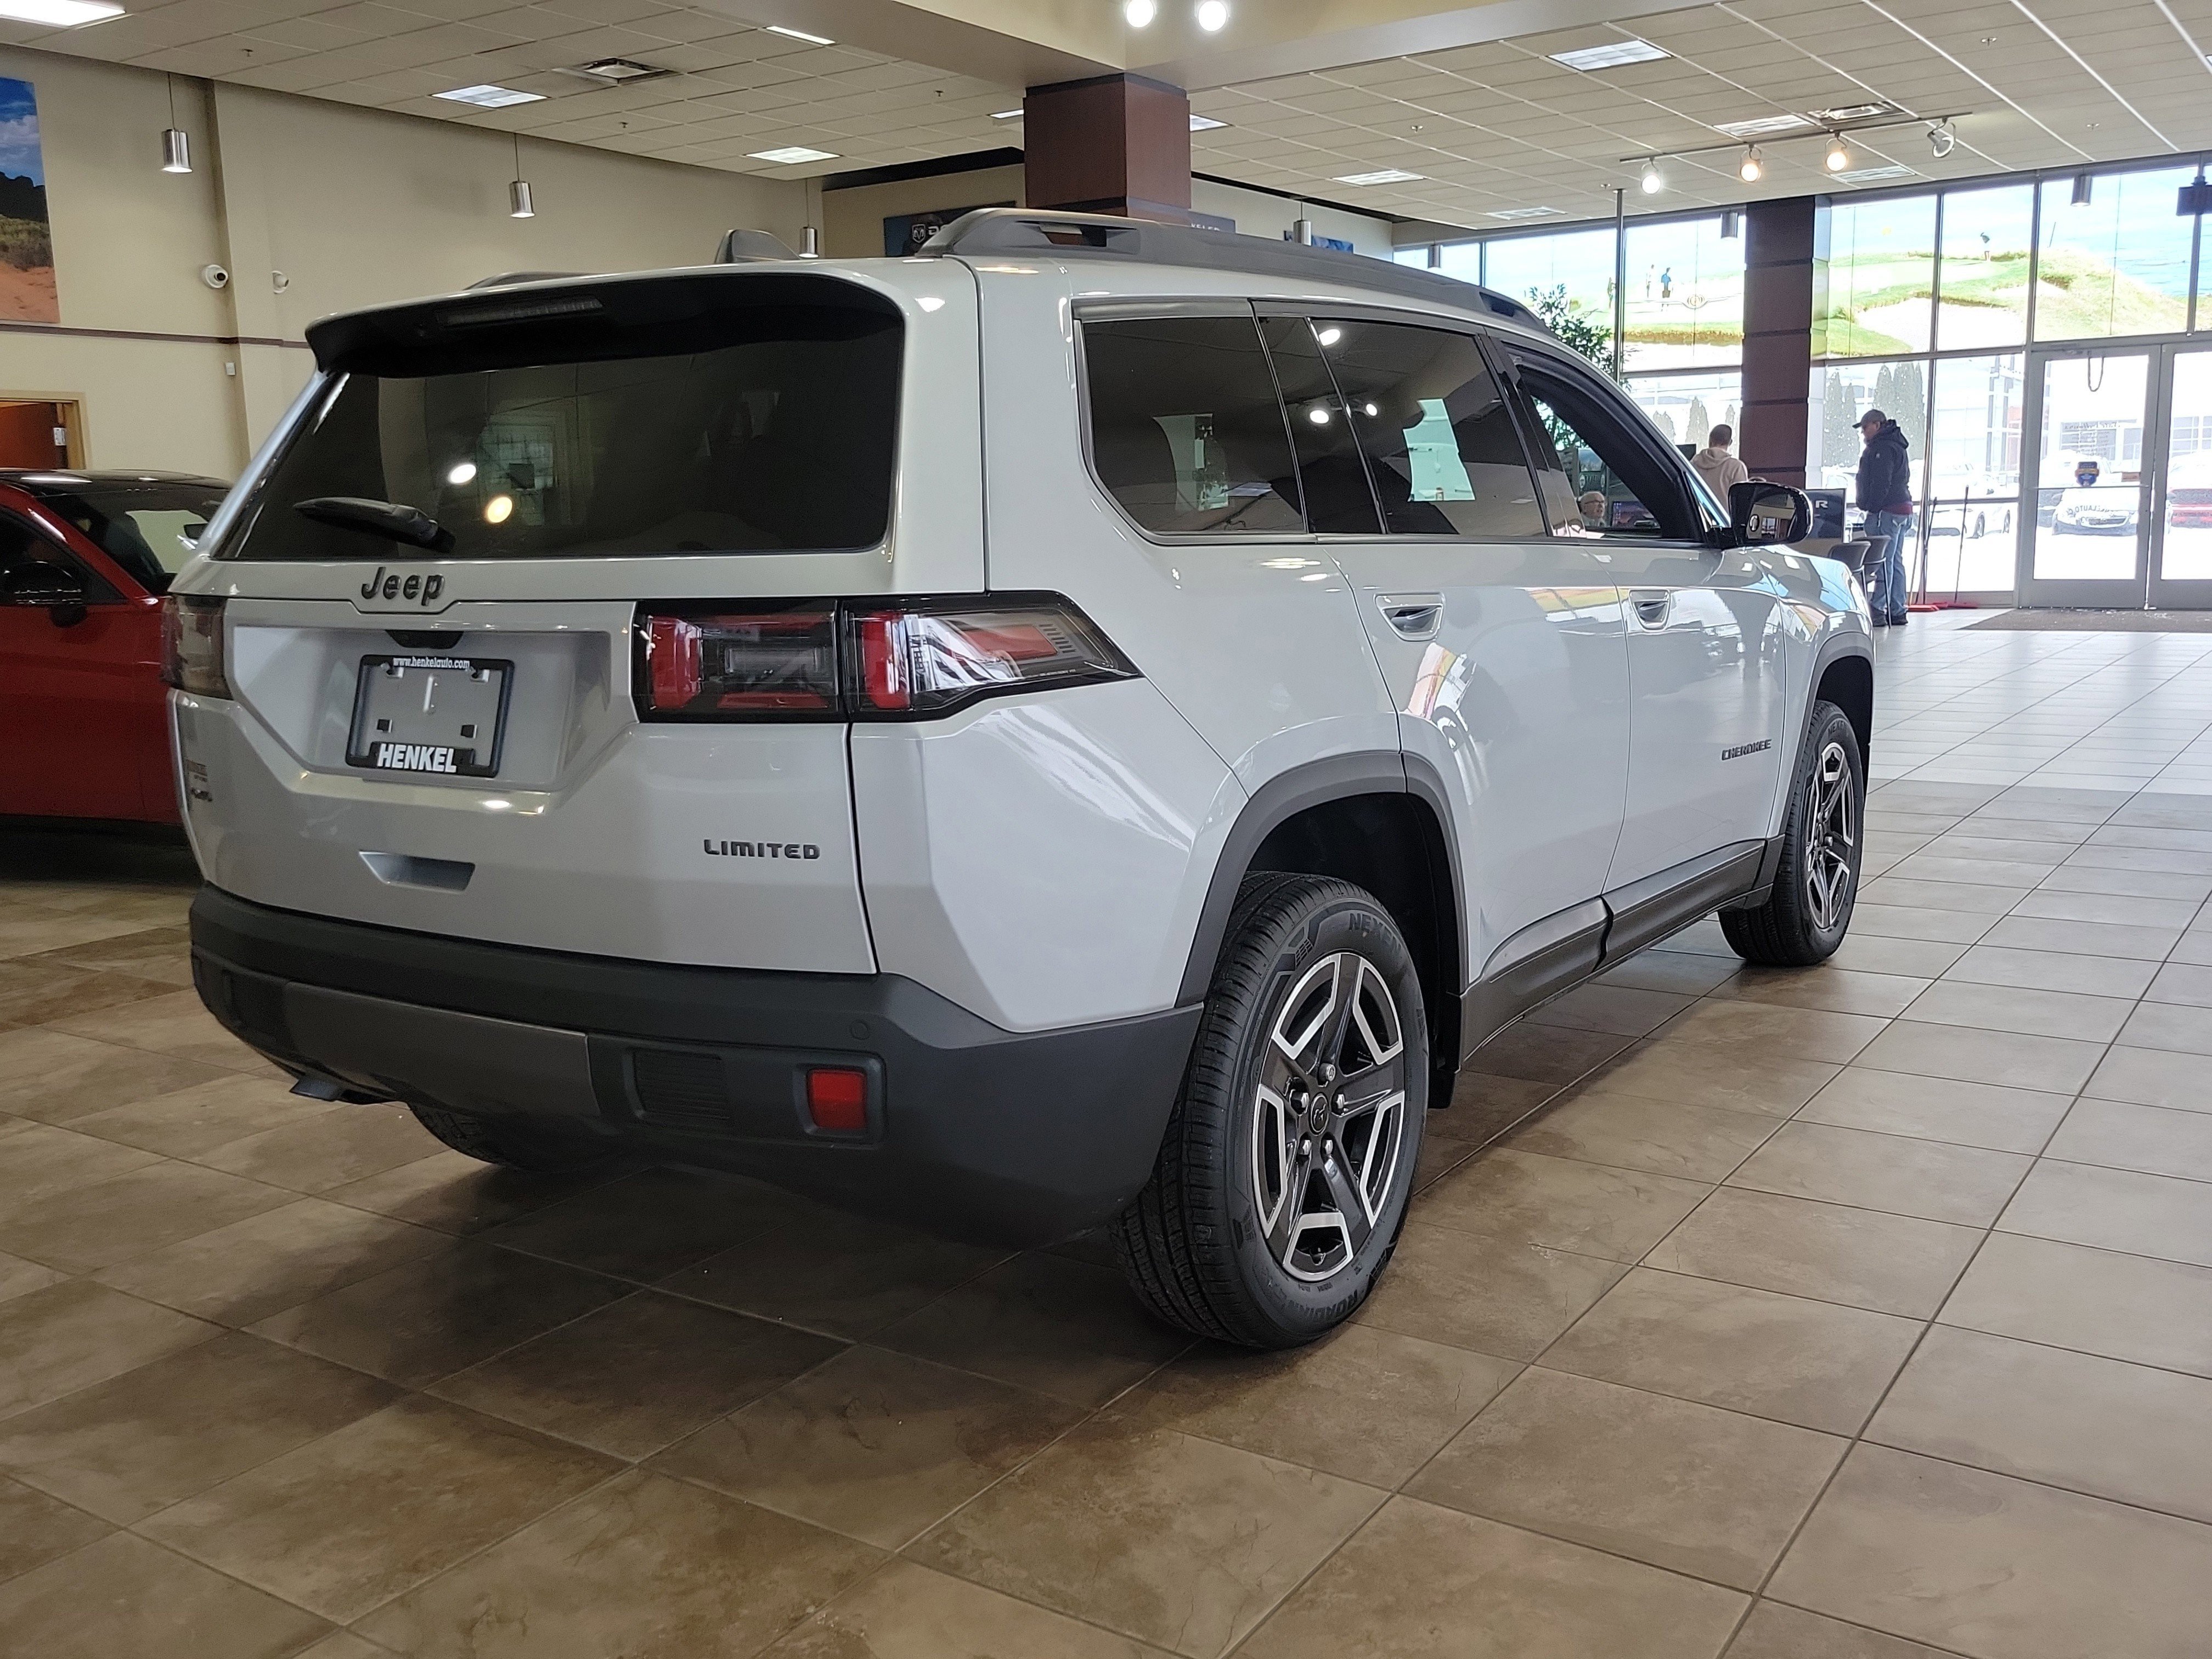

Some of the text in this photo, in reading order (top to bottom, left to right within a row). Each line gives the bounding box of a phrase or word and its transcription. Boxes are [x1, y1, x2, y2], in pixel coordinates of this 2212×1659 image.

[361, 567, 445, 606] Jeep
[377, 743, 457, 773] HENKEL
[1722, 739, 1772, 761] CHEROKEE
[703, 839, 821, 860] LIMITED
